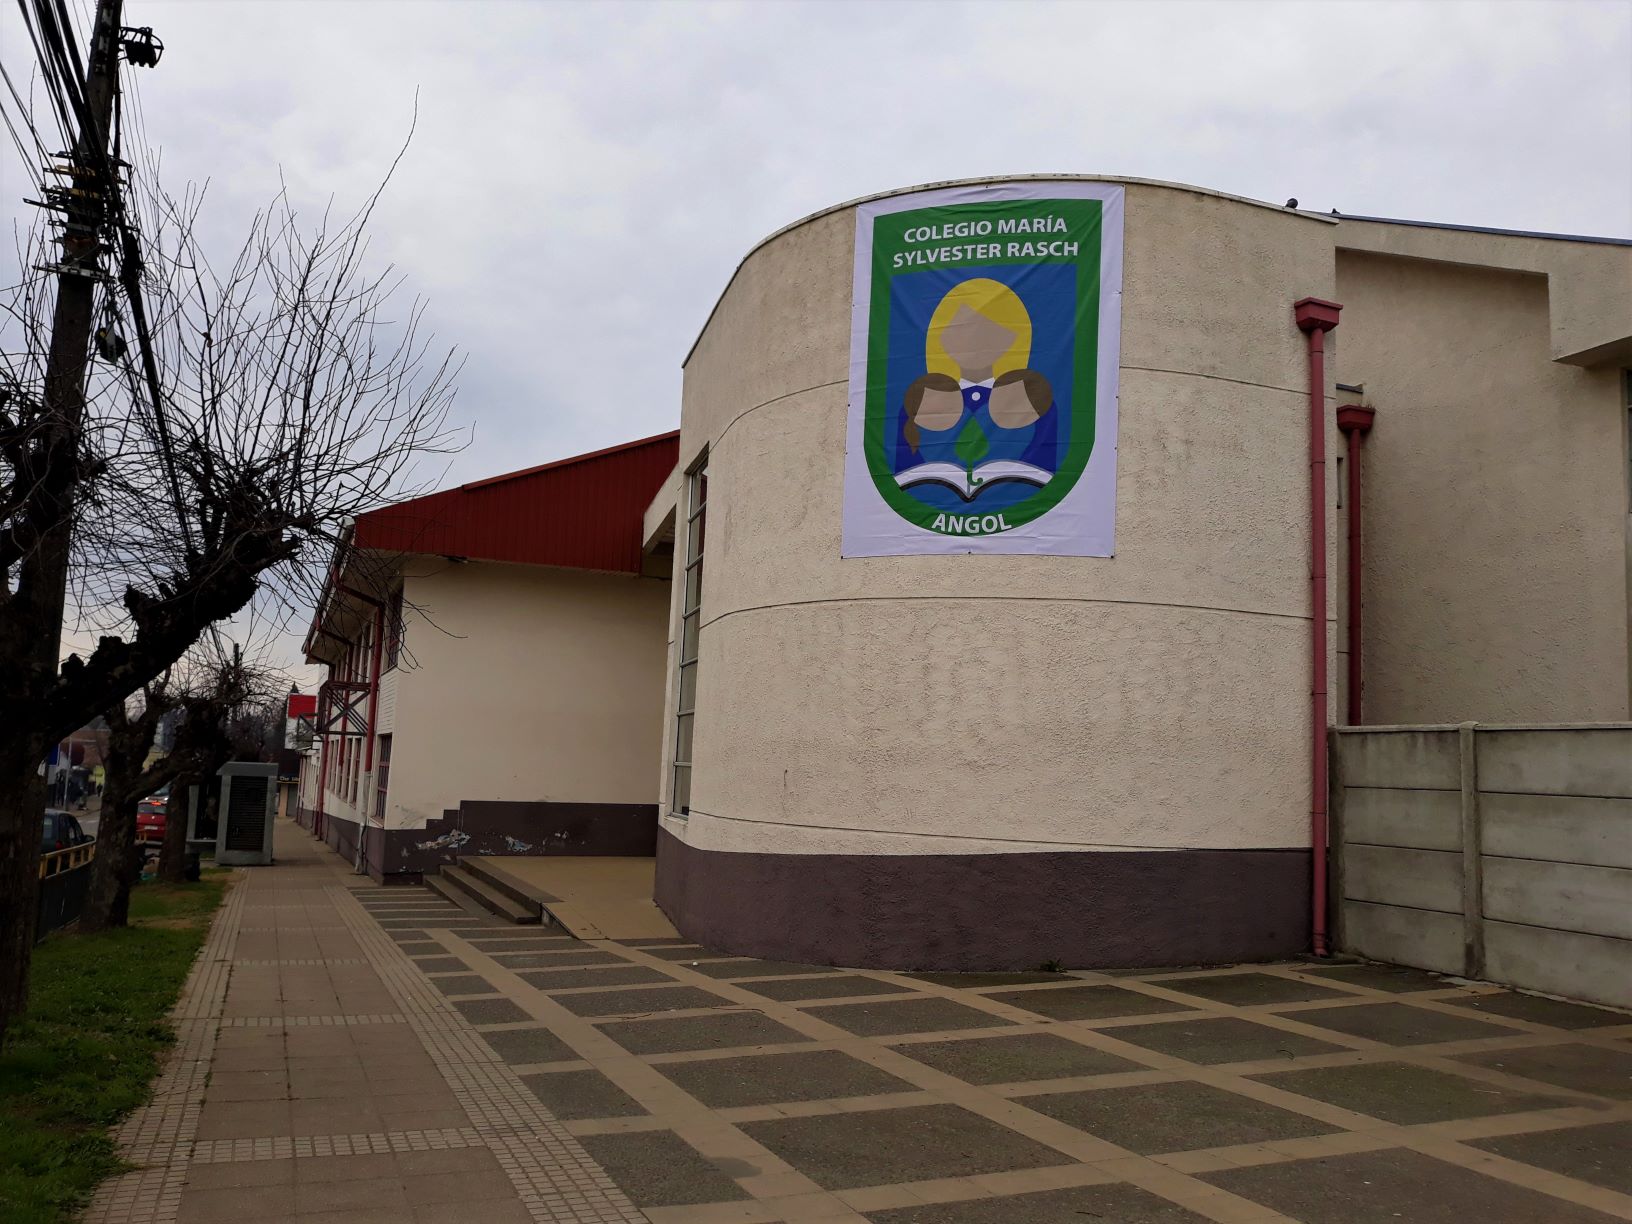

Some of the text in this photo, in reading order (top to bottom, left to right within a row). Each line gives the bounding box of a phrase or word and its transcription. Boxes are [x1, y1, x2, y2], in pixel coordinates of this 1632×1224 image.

[904, 215, 1068, 243] COLEGIO MARÍA
[893, 241, 1078, 268] SYLVESTER RASCH
[931, 513, 1012, 534] ANGOL
